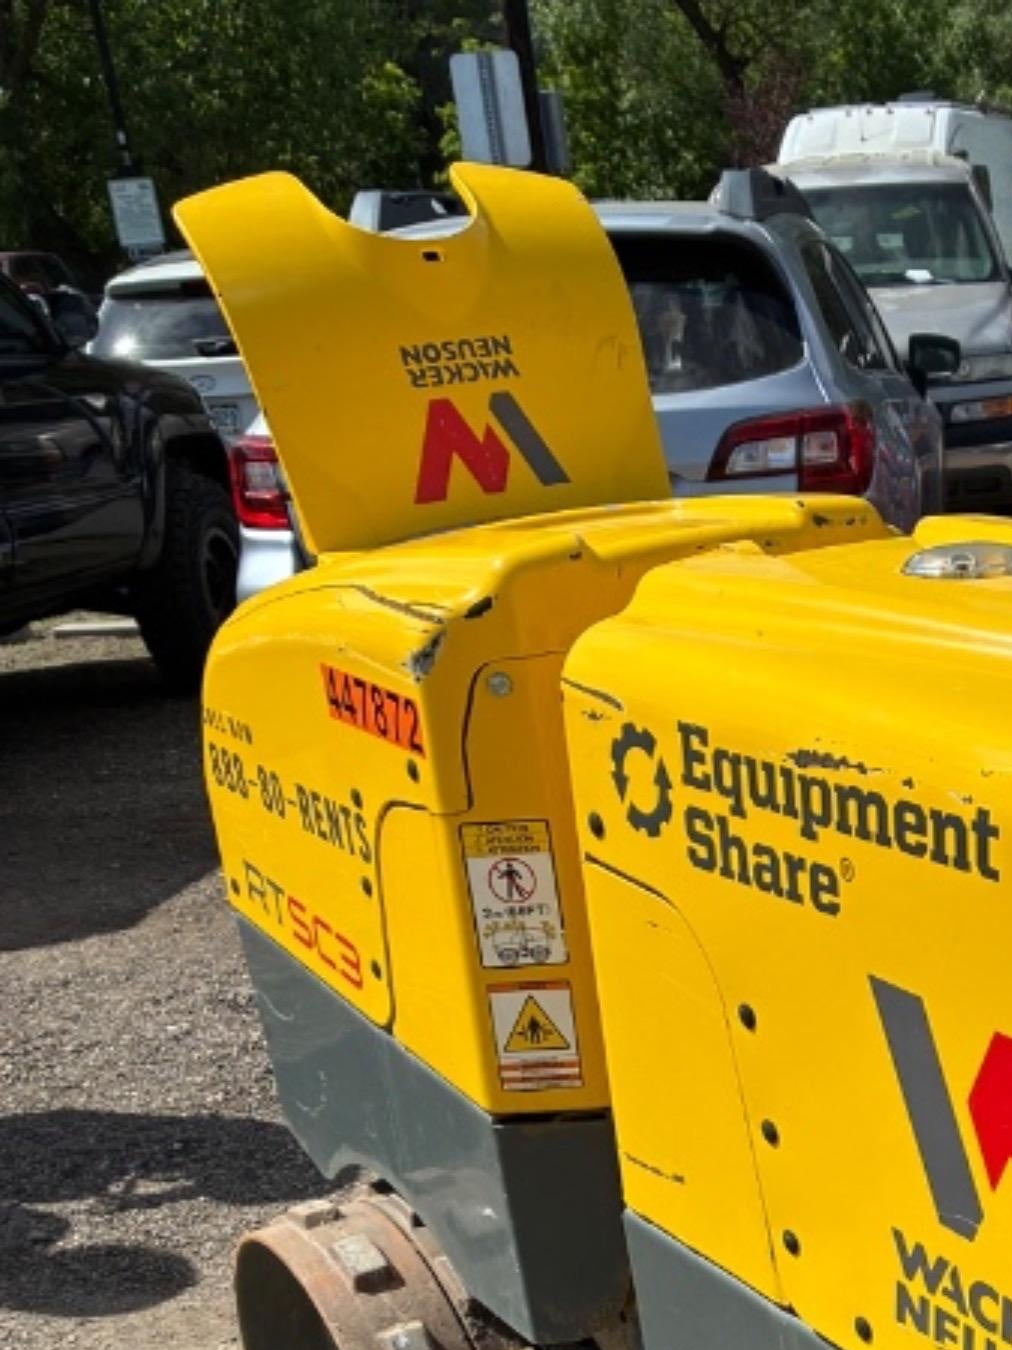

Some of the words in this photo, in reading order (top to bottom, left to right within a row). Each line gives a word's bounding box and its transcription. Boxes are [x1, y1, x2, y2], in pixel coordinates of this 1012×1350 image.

[400, 335, 513, 367] NEUSON
[326, 667, 424, 754] 447872
[677, 719, 1000, 883] Equipment
